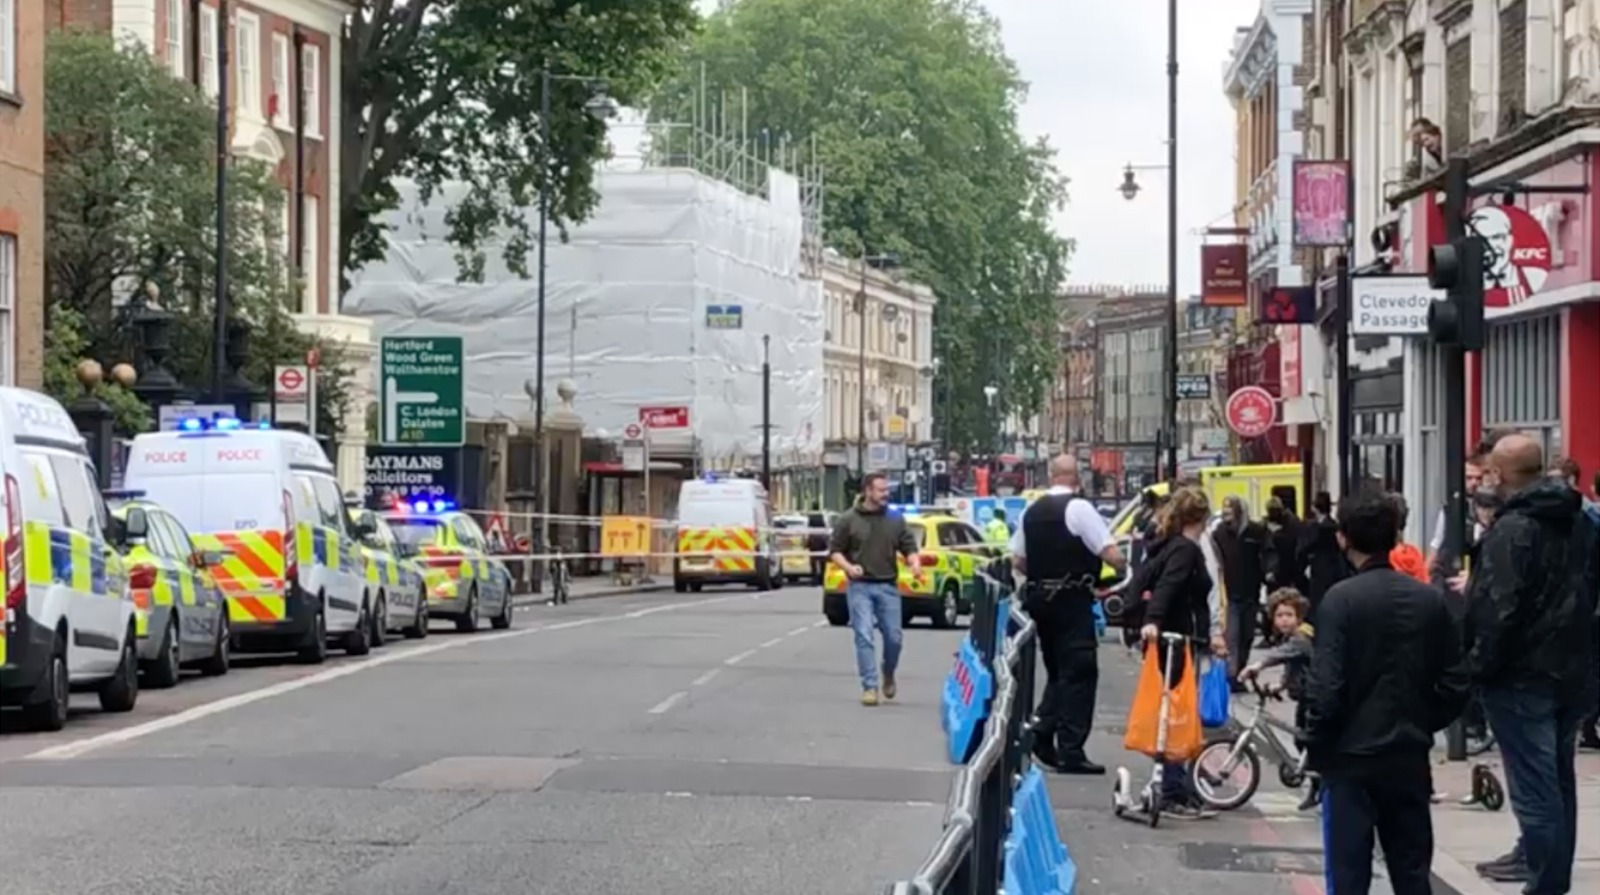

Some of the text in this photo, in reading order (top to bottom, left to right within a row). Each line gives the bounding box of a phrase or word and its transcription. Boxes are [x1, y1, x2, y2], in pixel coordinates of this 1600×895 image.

[1513, 247, 1548, 260] KFC
[1360, 294, 1429, 309] Clevedo
[385, 340, 434, 351] Hertford
[385, 352, 454, 363] Wood Green
[385, 364, 459, 375] Walthamstow
[417, 406, 459, 417] London
[145, 451, 187, 463] POLICE
[217, 449, 261, 461] POLICE
